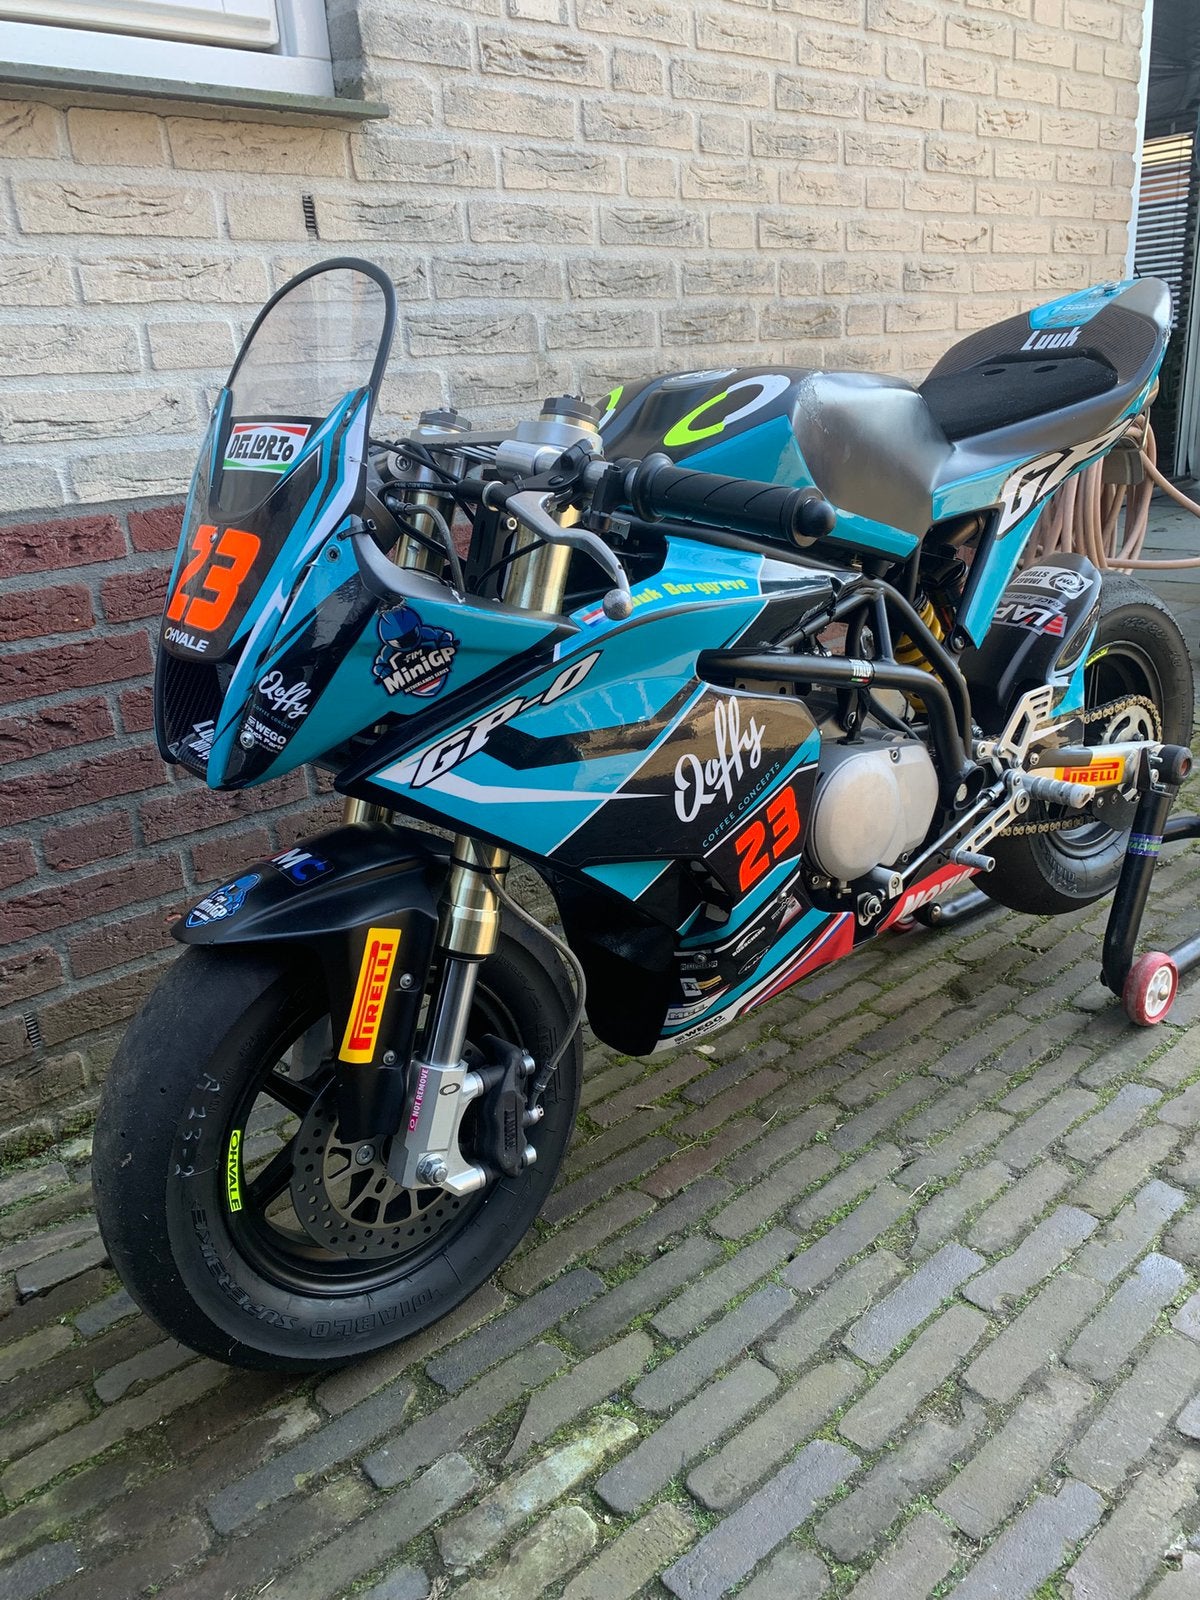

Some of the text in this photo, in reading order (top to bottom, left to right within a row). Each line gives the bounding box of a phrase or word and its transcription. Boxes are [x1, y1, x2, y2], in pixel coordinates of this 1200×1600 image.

[1020, 326, 1082, 351] Luuk
[227, 434, 295, 462] DELLORTO
[166, 524, 262, 632] 23
[165, 626, 210, 653] OHVALE
[383, 646, 456, 695] MiniGP
[254, 720, 287, 745] WEGO
[702, 762, 781, 848] COFFEE CONCEPTS
[735, 786, 800, 892] 23
[347, 940, 394, 1051] PIRELLI
[684, 1015, 724, 1038] WEGO
[412, 1067, 430, 1118] NOT REMOVE
[228, 1130, 242, 1212] OHVALE
